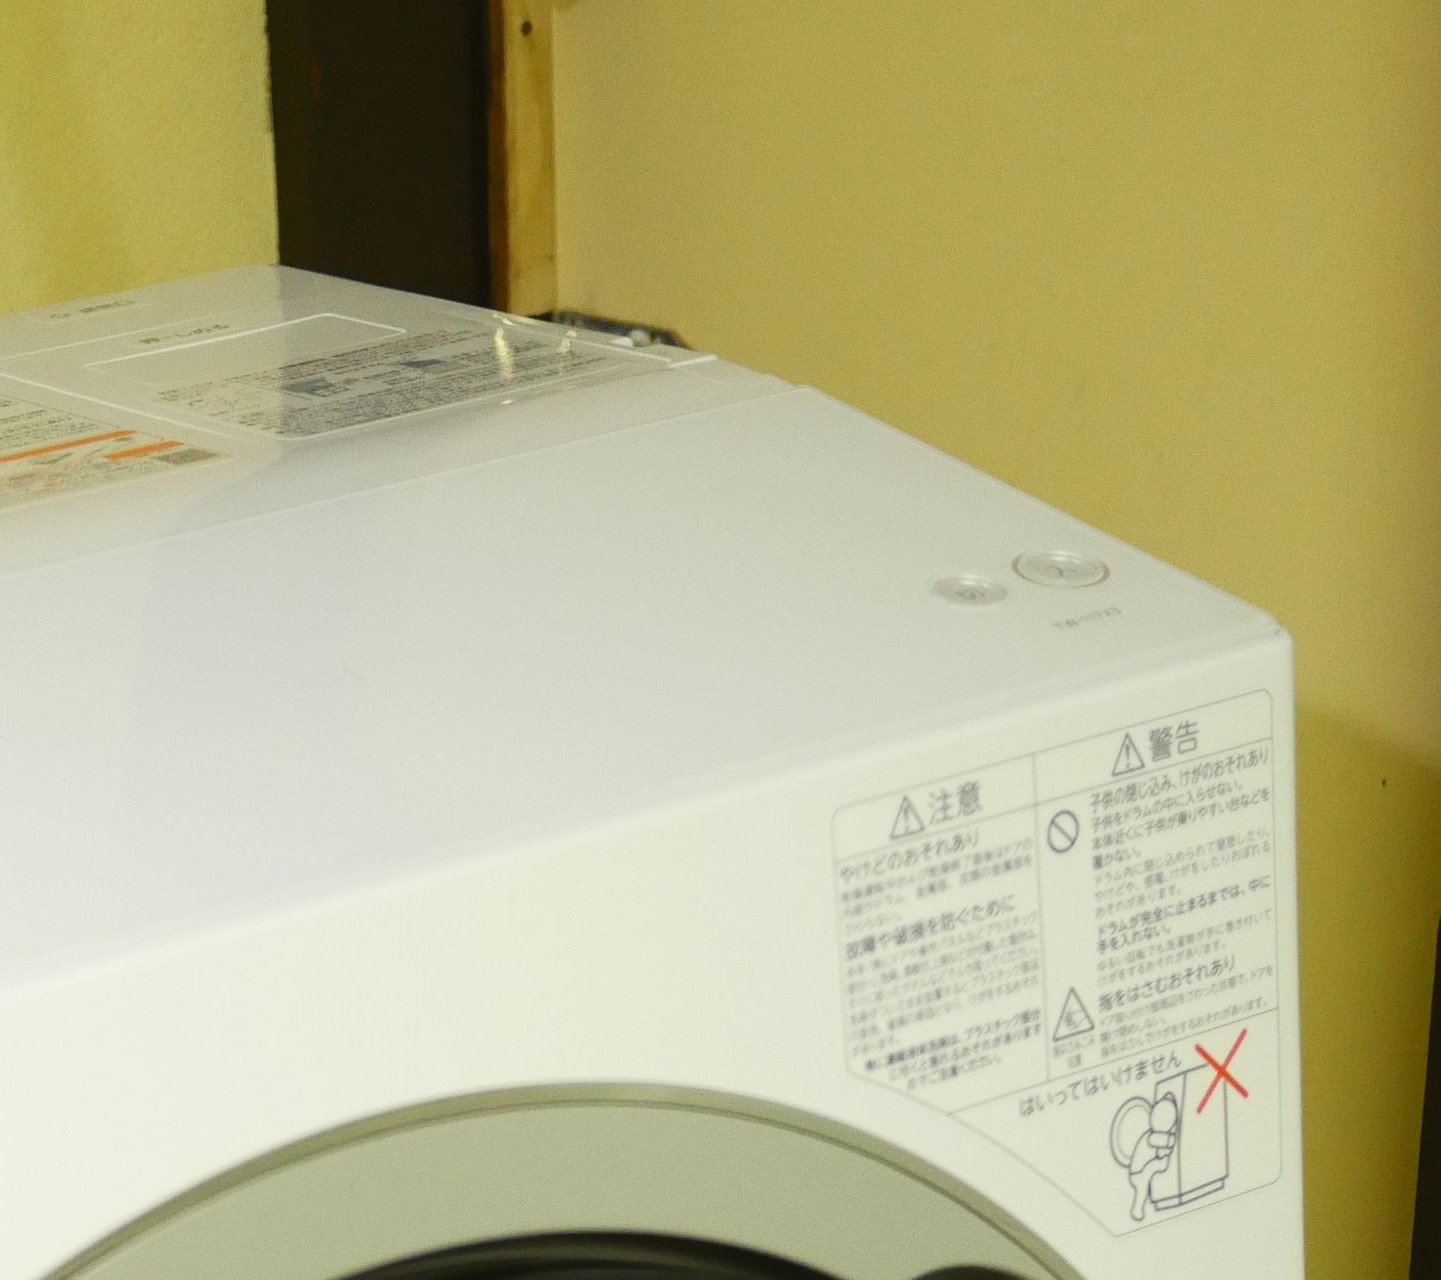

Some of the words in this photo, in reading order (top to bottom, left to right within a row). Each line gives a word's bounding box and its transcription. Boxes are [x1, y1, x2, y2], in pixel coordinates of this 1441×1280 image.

[1148, 716, 1199, 764] 警告
[927, 777, 983, 827] 注意
[1019, 1048, 1181, 1117] はいってはいけません
